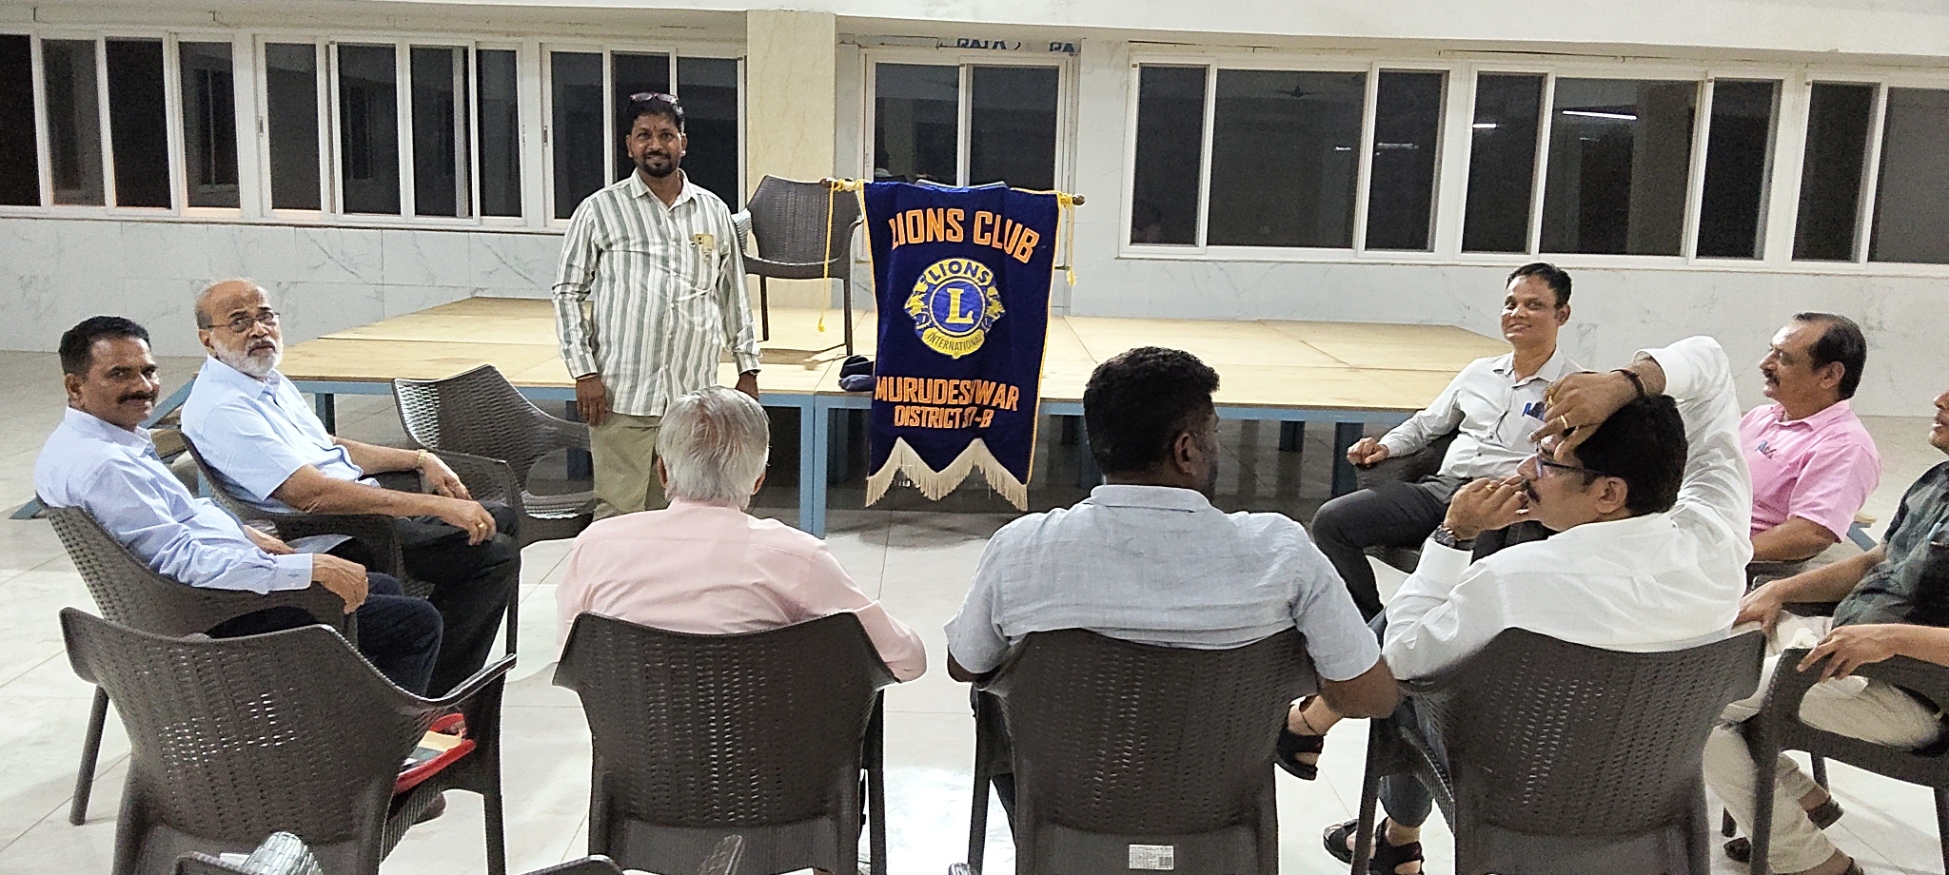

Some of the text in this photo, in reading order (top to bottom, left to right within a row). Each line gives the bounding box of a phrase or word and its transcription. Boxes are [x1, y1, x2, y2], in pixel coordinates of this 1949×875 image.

[888, 208, 1040, 264] LIONS CLUB
[928, 260, 990, 283] LIONS
[945, 288, 974, 324] L
[927, 331, 983, 351] INTERNATIONAL
[894, 405, 963, 429] DISTRICT
